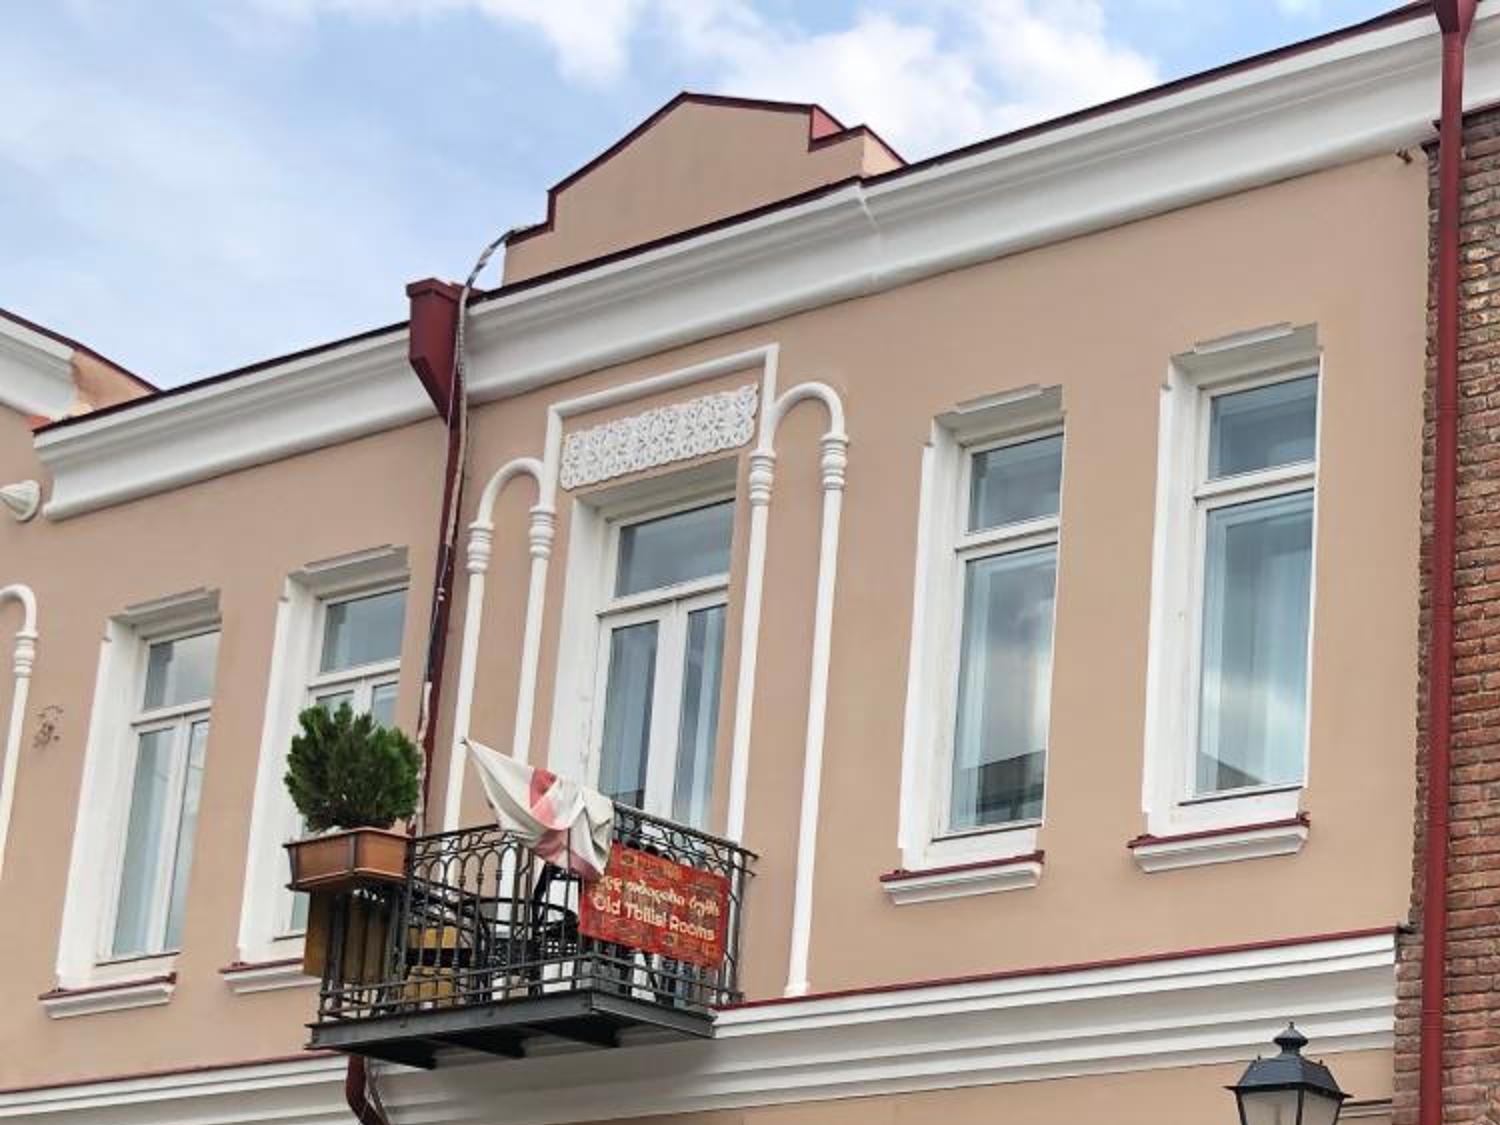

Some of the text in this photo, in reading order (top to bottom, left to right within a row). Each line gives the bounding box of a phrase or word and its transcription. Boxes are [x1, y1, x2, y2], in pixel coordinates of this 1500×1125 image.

[592, 893, 715, 941] Old Tbilisi Rooms
